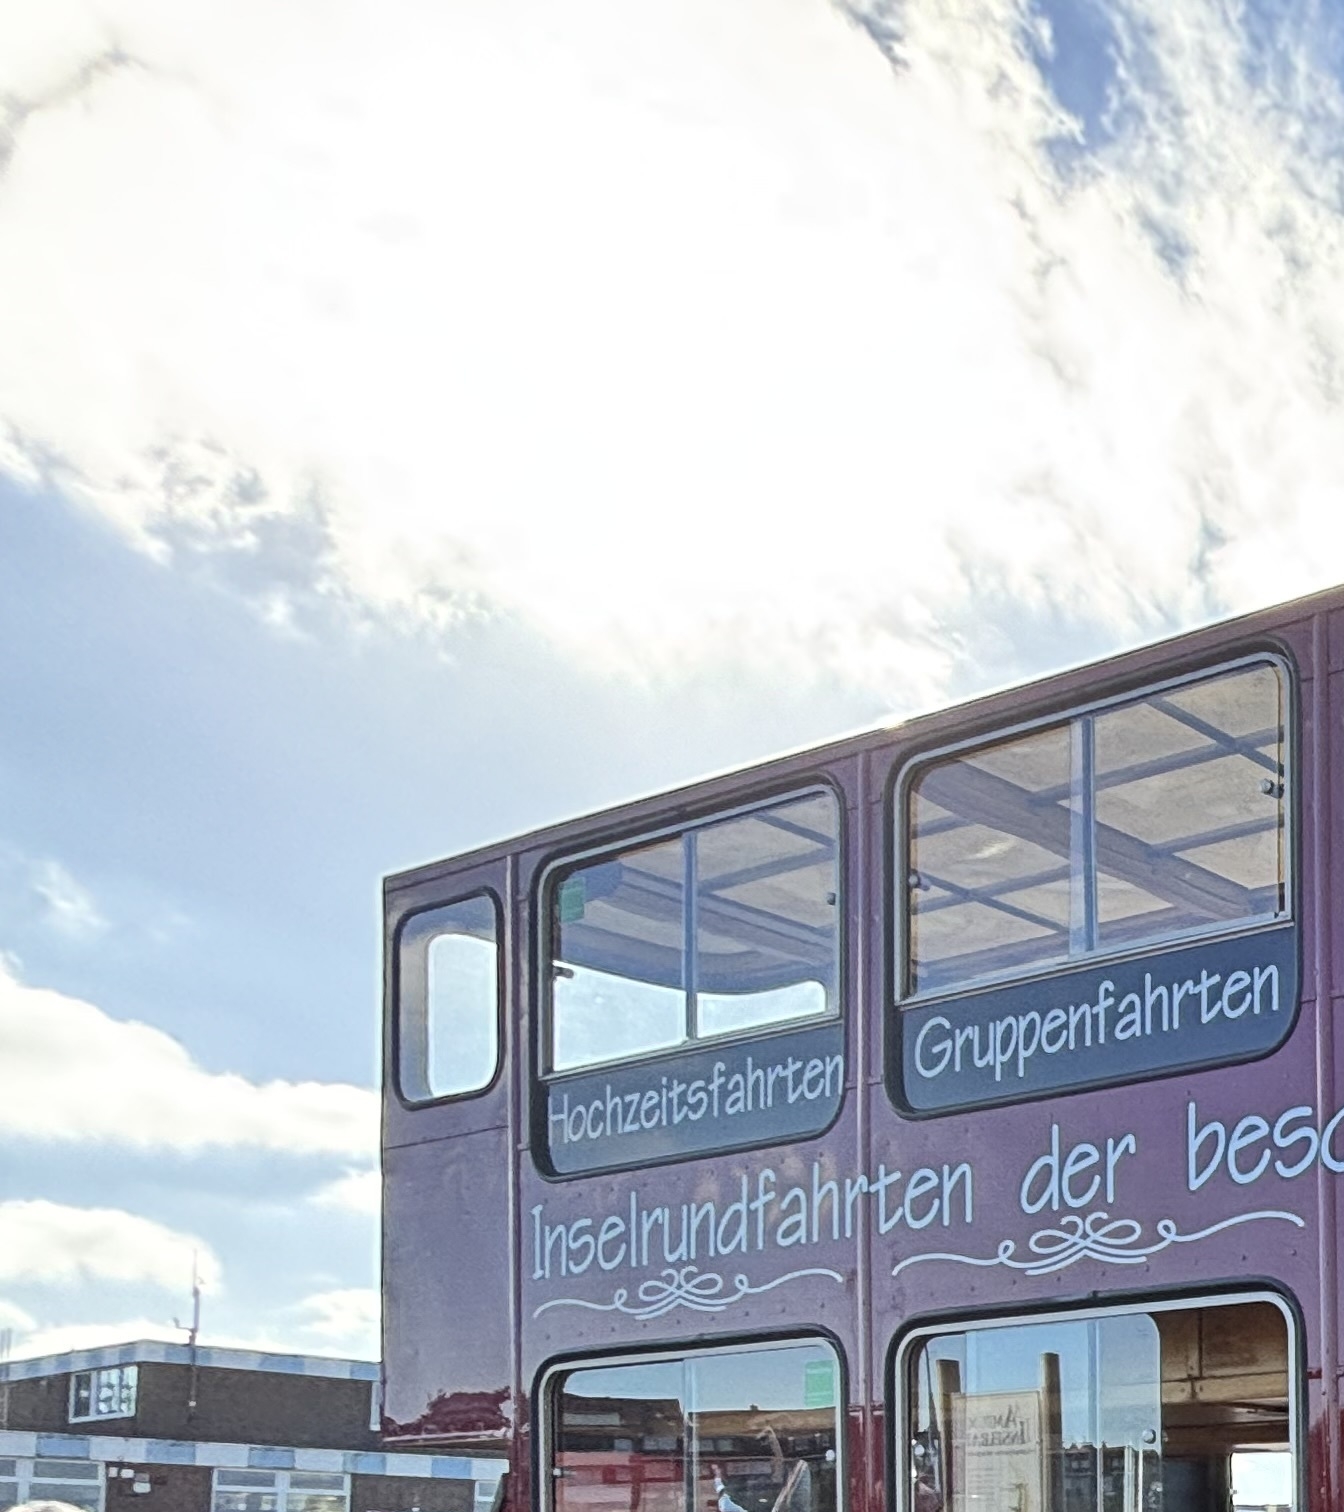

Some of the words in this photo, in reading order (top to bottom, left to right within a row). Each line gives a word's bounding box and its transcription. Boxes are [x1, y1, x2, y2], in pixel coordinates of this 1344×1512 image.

[913, 960, 1281, 1082] Gruppenfahrten
[548, 1053, 844, 1144] Hochzeitsfahrten
[530, 1161, 974, 1281] Inselrundfahrten
[1019, 1122, 1137, 1215] der
